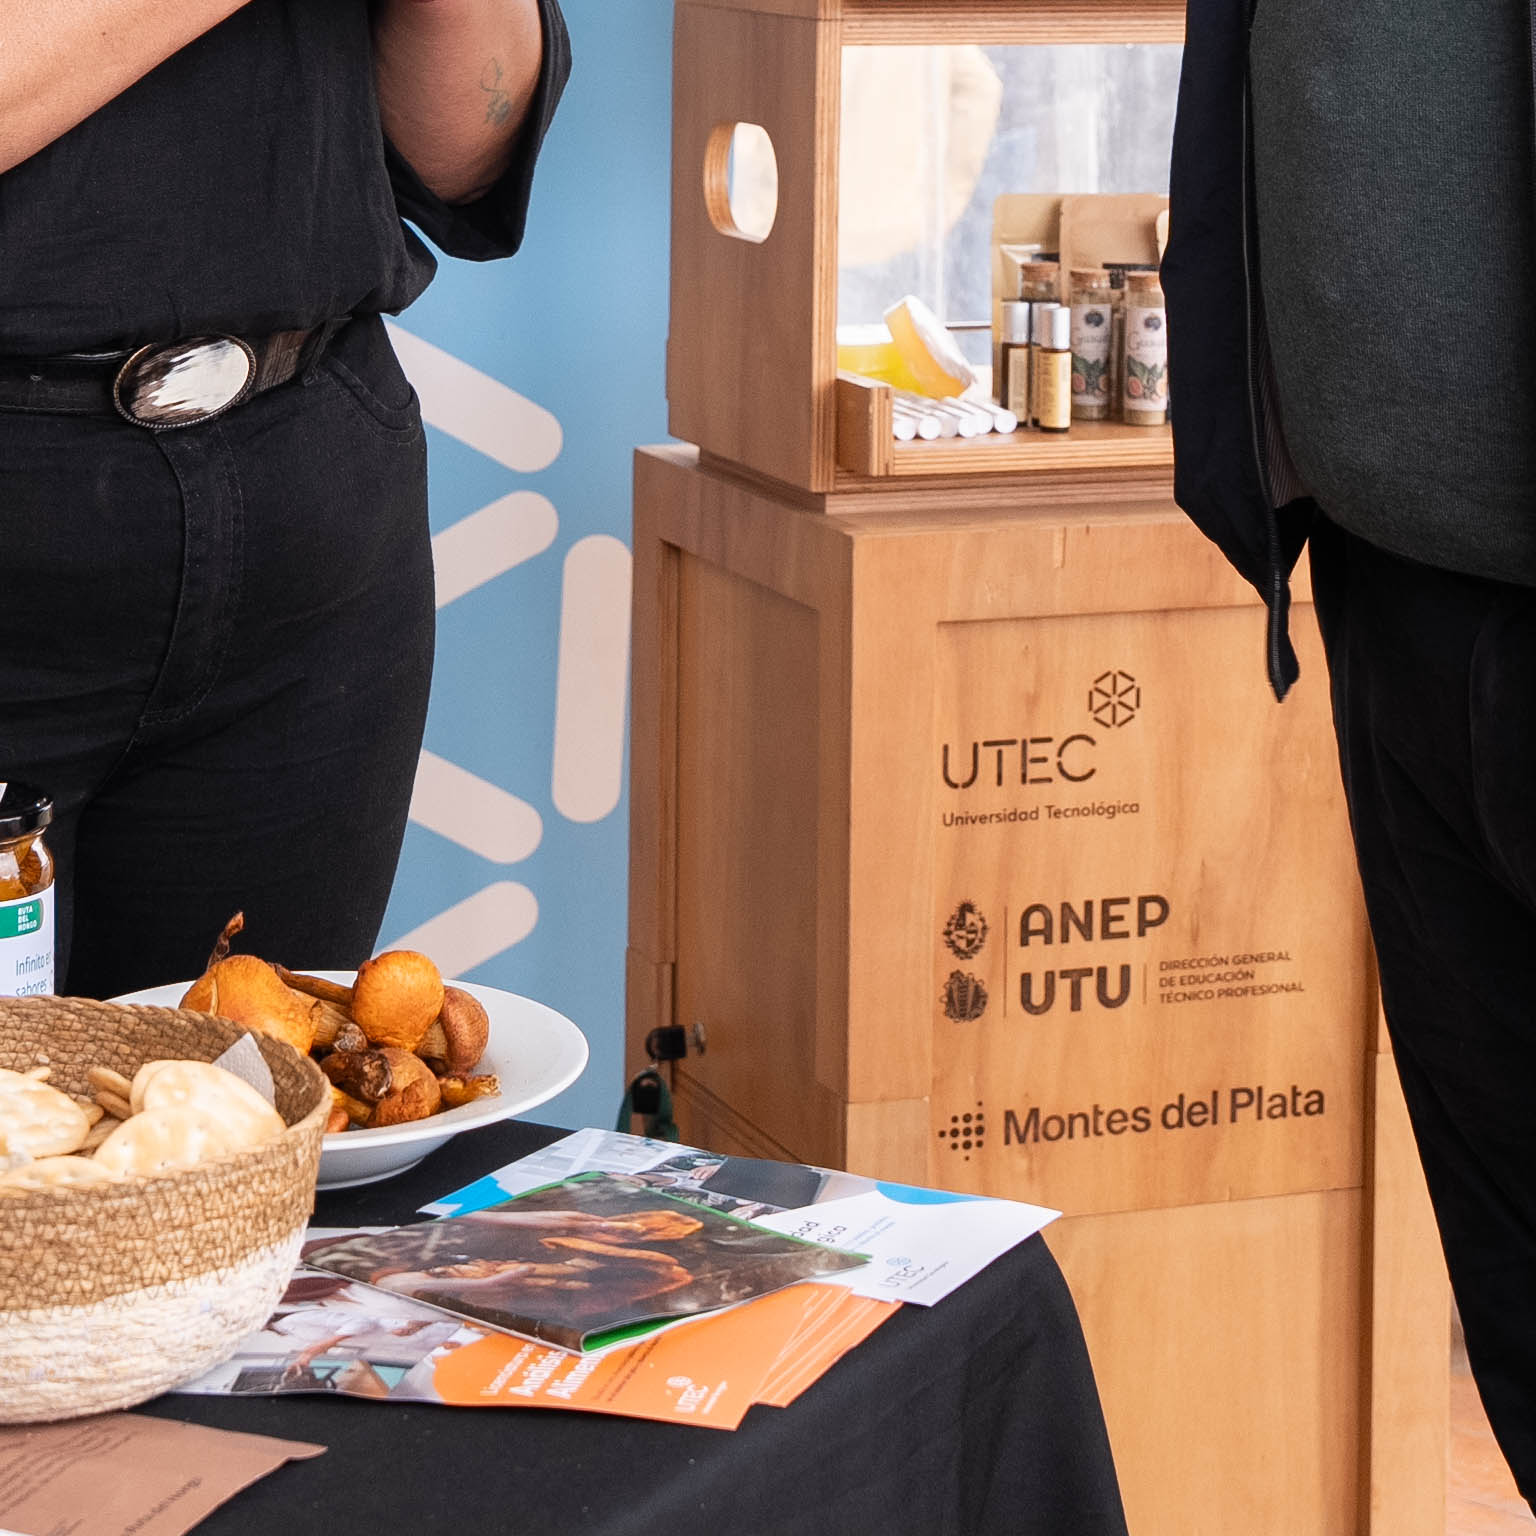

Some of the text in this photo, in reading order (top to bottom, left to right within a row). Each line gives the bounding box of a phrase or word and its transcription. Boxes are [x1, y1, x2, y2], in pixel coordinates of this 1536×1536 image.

[942, 733, 1097, 790] UTEC
[942, 800, 1141, 828] Universidad Tecnológica
[18, 906, 34, 916] RUTA
[18, 914, 30, 925] DEL
[1019, 894, 1171, 948] ANEP
[18, 920, 38, 932] HONGO
[16, 954, 45, 977] Infinito
[1159, 950, 1292, 972] DIRECCIÓN GENERAL
[1020, 963, 1131, 1016] UTU
[1159, 969, 1256, 988] DE EDUCACIÓN
[1159, 981, 1305, 1004] TÉCNICO PROFESIONAL
[1003, 1084, 1326, 1146] Montes del Plata
[545, 1352, 604, 1401] Alimen
